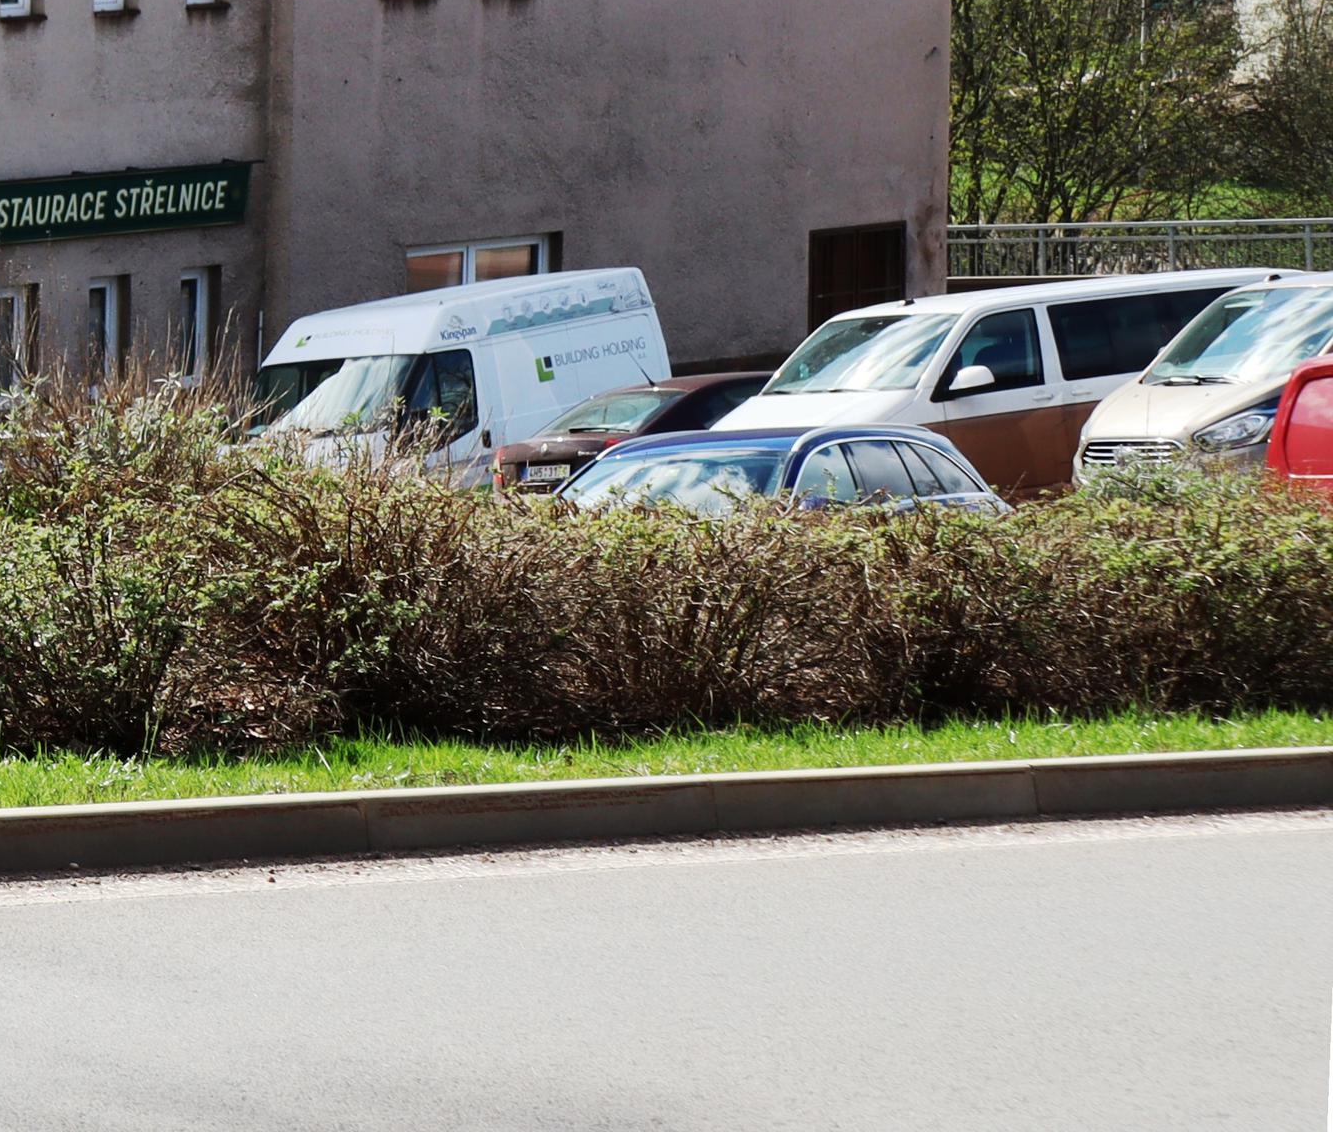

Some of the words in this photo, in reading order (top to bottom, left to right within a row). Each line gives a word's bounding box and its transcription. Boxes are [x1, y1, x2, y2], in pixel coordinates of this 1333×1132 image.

[114, 179, 228, 218] STŘELNICE
[440, 326, 477, 340] Kingspan
[554, 346, 600, 367] BUILDING
[602, 336, 646, 356] HOLDING
